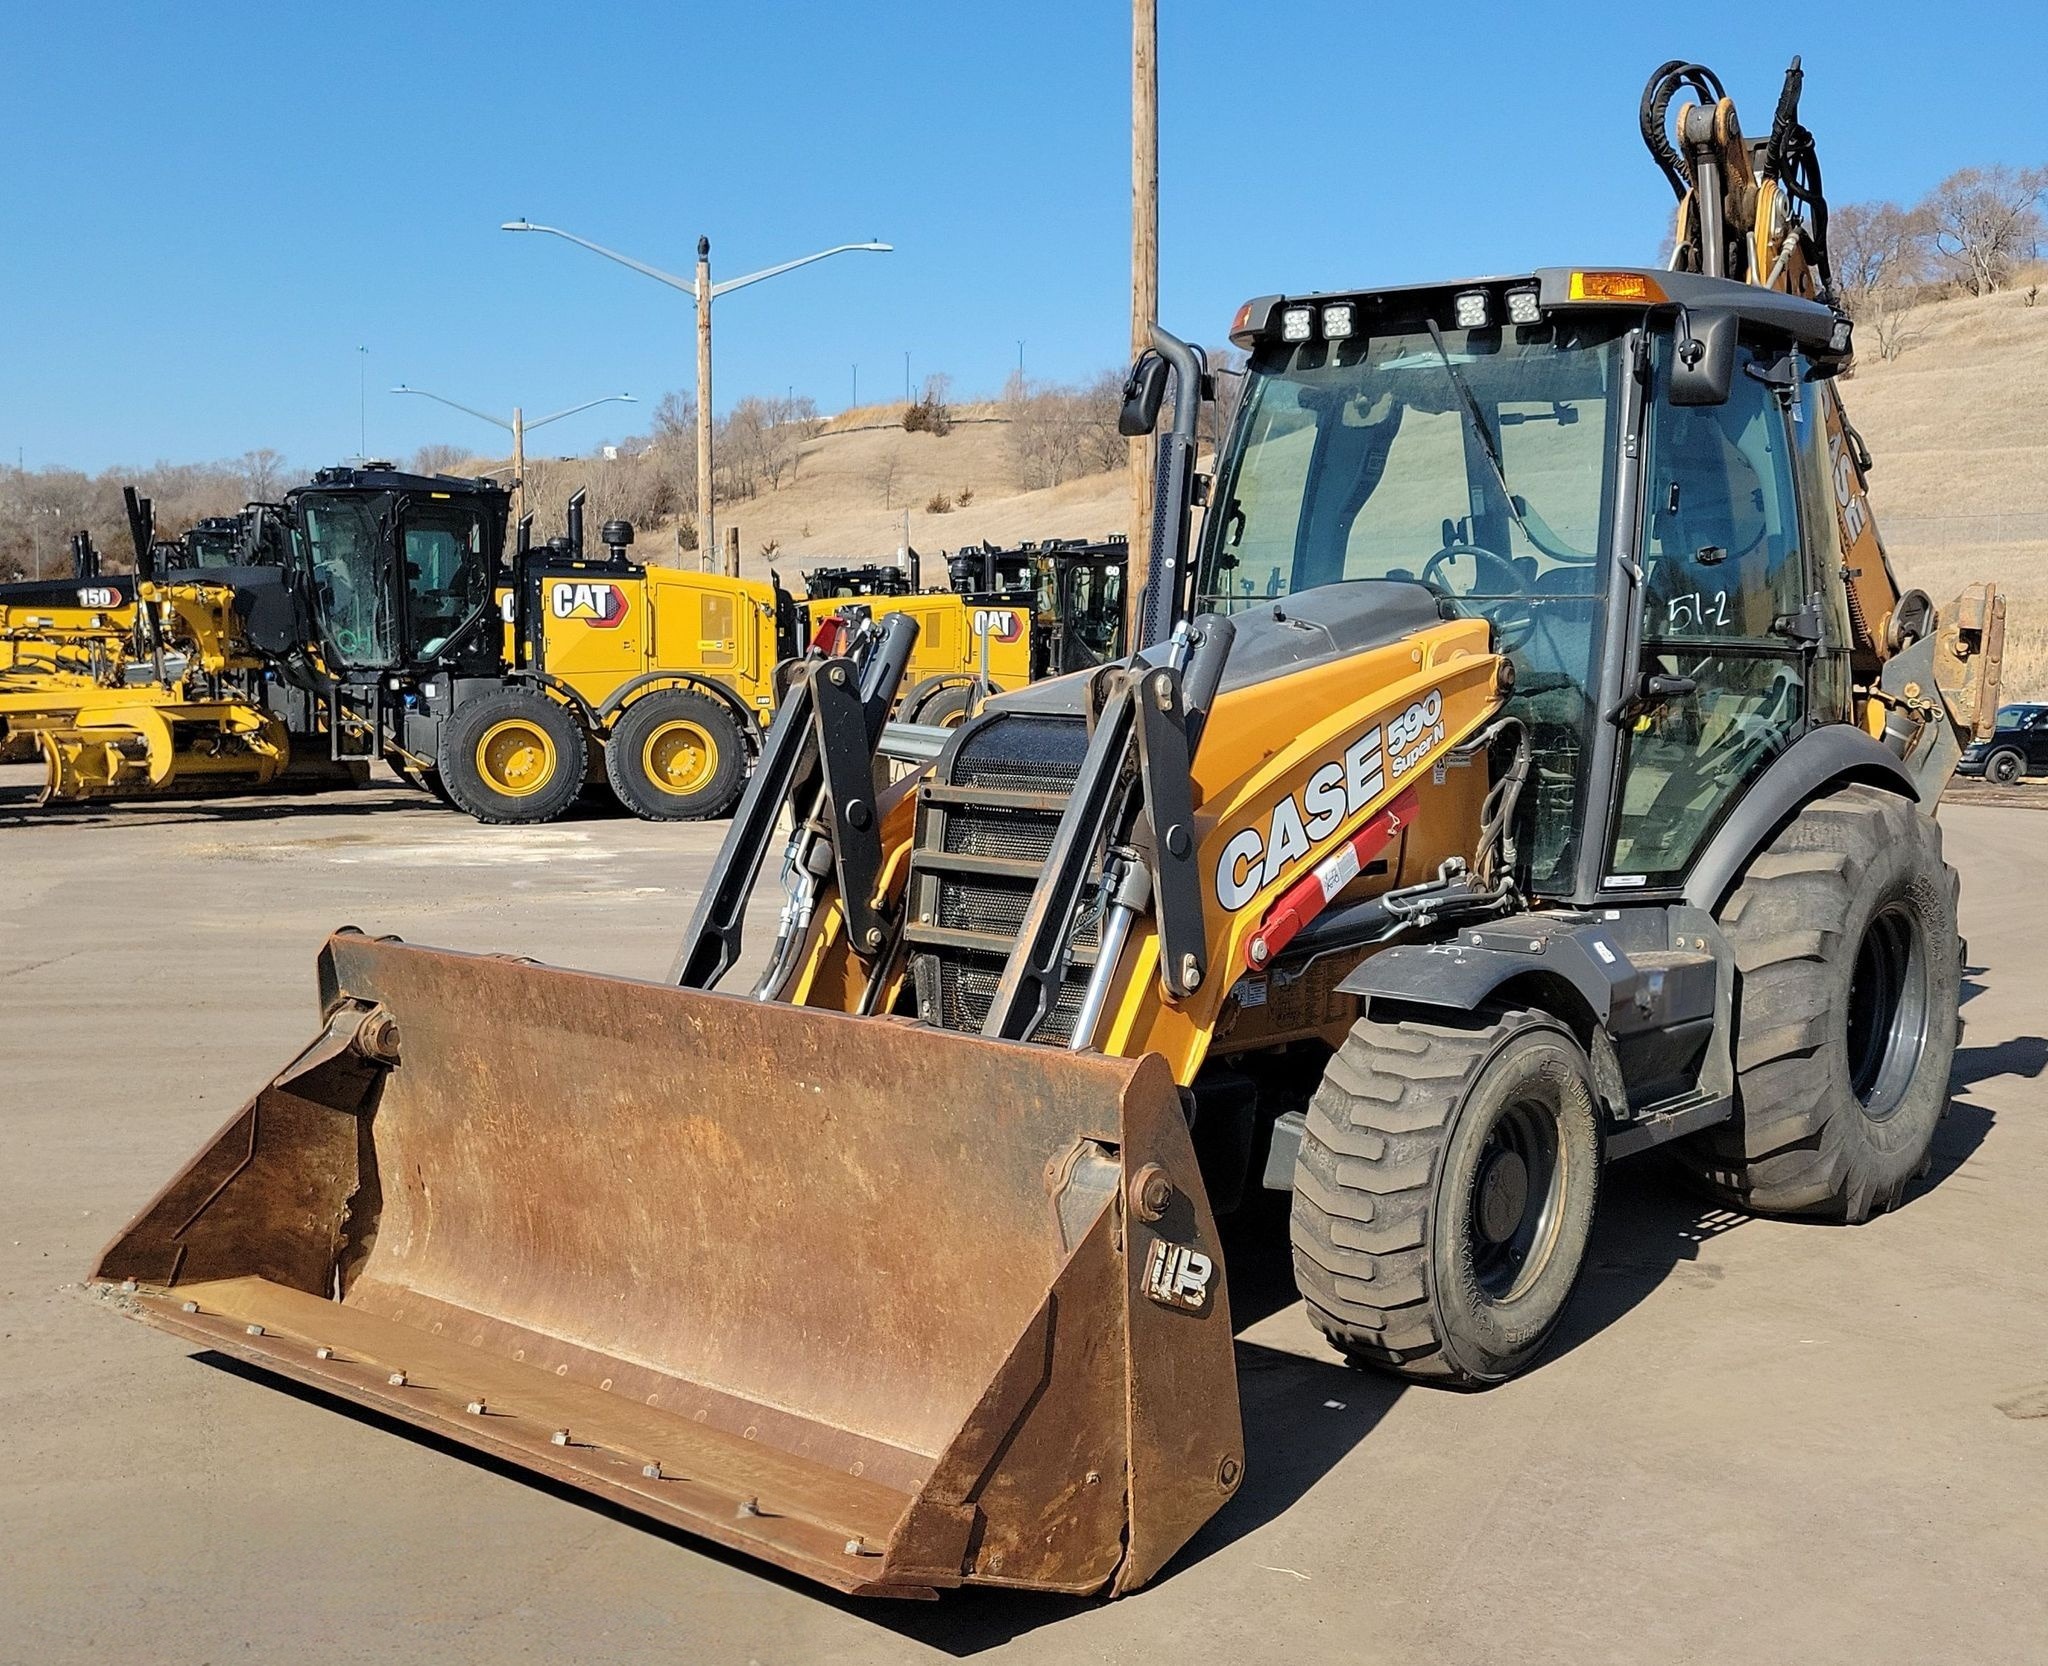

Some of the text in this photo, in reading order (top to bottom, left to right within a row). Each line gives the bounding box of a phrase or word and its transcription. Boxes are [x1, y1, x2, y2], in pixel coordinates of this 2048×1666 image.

[77, 587, 111, 607] 150
[553, 583, 611, 620] CAT
[1667, 590, 1731, 631] 51-2
[974, 610, 1012, 636] CAT
[1387, 688, 1443, 756] 590
[1392, 733, 1433, 778] Super
[1216, 723, 1385, 912] CASE
